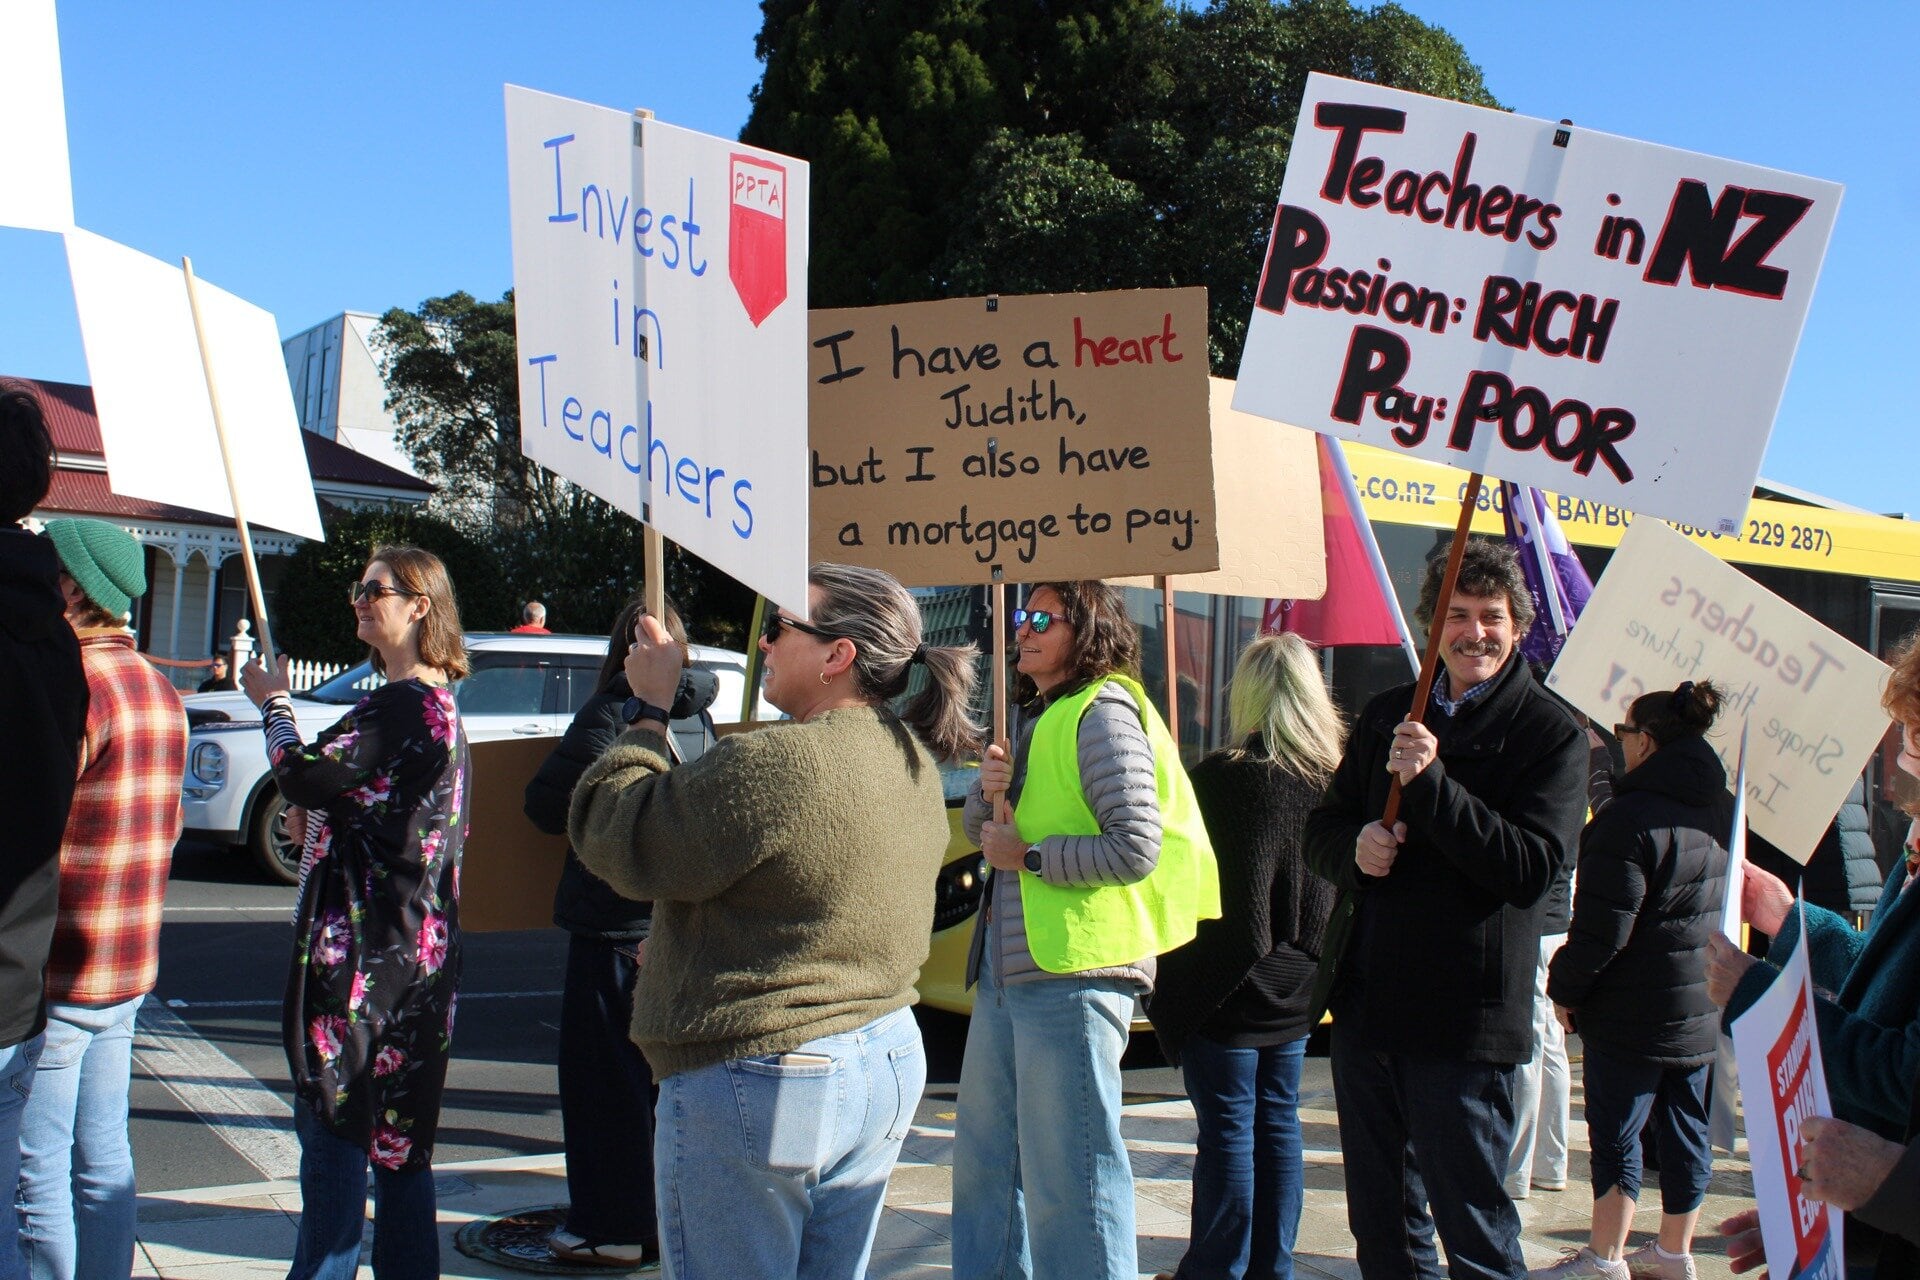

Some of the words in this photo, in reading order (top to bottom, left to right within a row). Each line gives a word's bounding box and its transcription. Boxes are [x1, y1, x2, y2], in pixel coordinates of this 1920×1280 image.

[544, 134, 707, 276] Invest
[734, 170, 781, 208] PPTA
[1314, 101, 1562, 250] Teachers
[1594, 193, 1646, 264] in
[1642, 177, 1815, 300] NZ
[1255, 204, 1467, 334] Passion:
[1473, 275, 1620, 363] RICH
[613, 280, 662, 369] in
[813, 330, 865, 384] I
[891, 324, 1001, 379] have
[1023, 341, 1060, 369] a
[1074, 313, 1183, 367] heart
[940, 379, 1087, 430] Judith,
[1330, 324, 1448, 448] Pay:
[1446, 370, 1637, 485] POOR
[528, 354, 753, 539] Teachers
[812, 447, 886, 488] but
[905, 447, 935, 482] I
[962, 448, 1040, 478] also
[1060, 437, 1150, 475] have
[838, 521, 863, 547] a
[888, 505, 1060, 564] mortgage
[1067, 503, 1111, 535] to
[1126, 508, 1200, 551] pay.
[1749, 520, 1785, 547] 229
[1790, 525, 1833, 557] 287)
